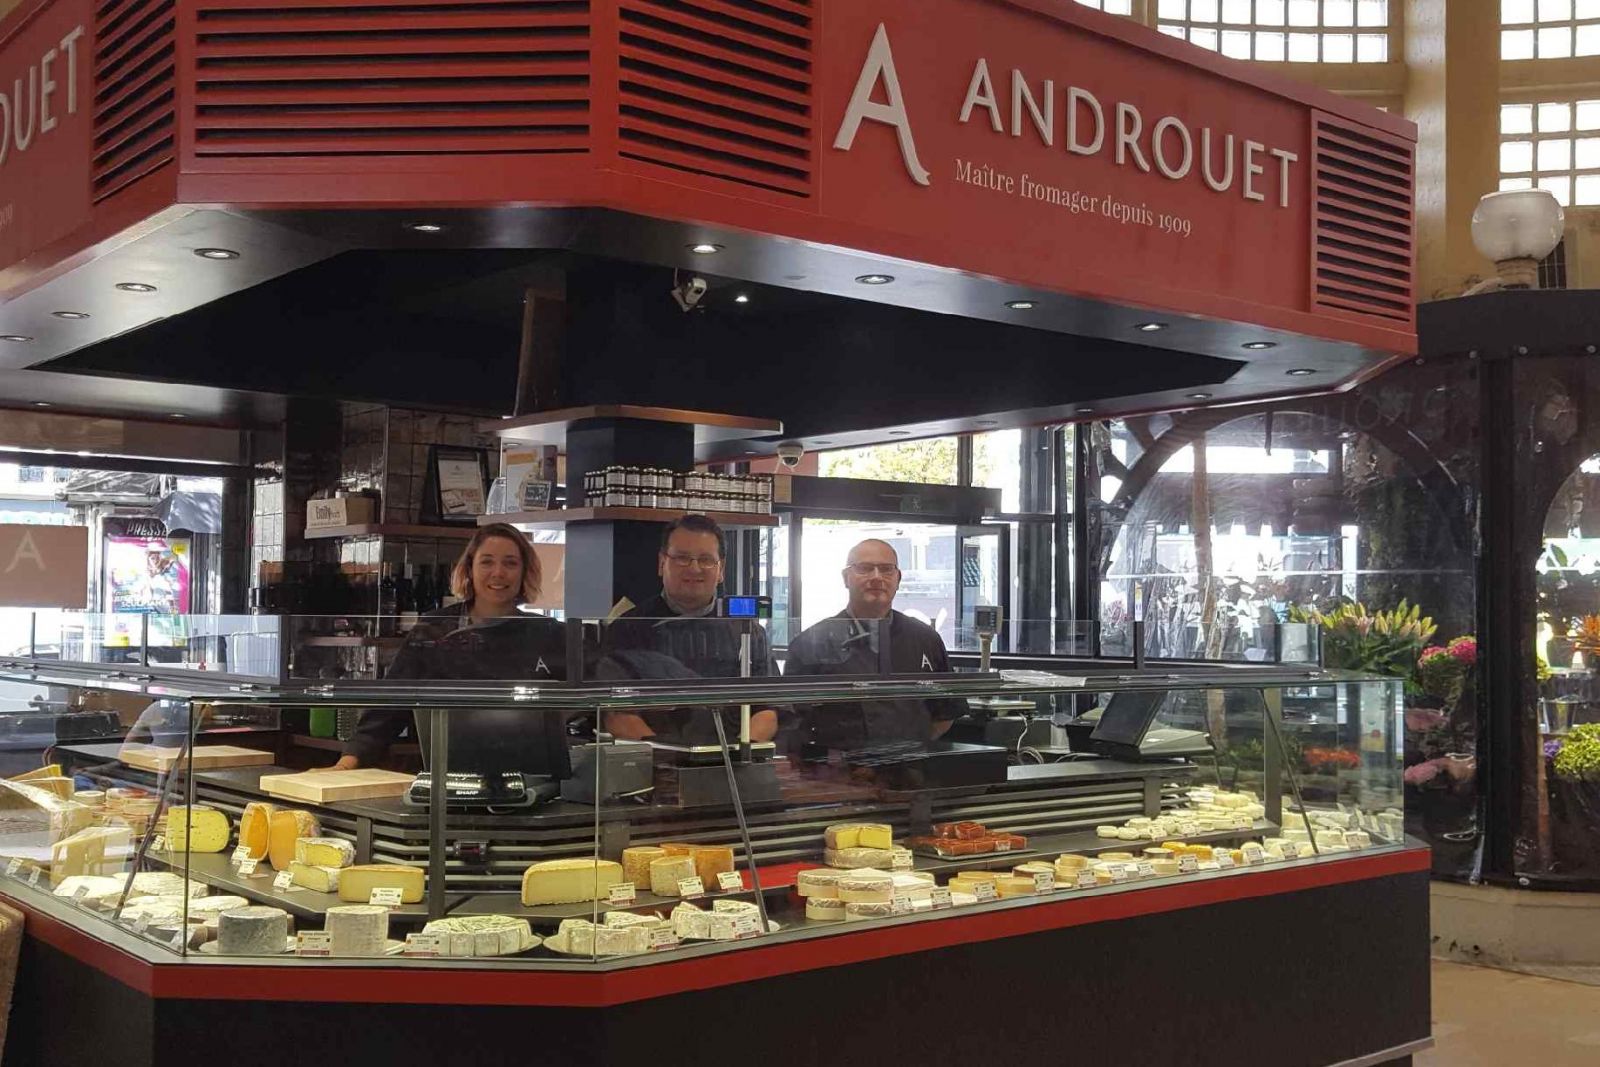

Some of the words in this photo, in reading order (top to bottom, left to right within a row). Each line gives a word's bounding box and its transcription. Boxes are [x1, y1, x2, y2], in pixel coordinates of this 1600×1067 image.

[958, 57, 1299, 209] ANDROUET
[955, 157, 1014, 194] Maître
[1019, 172, 1099, 213] fromager
[1102, 194, 1155, 228] depuis
[1158, 213, 1192, 238] 1909
[535, 656, 551, 674] A
[921, 652, 934, 673] A
